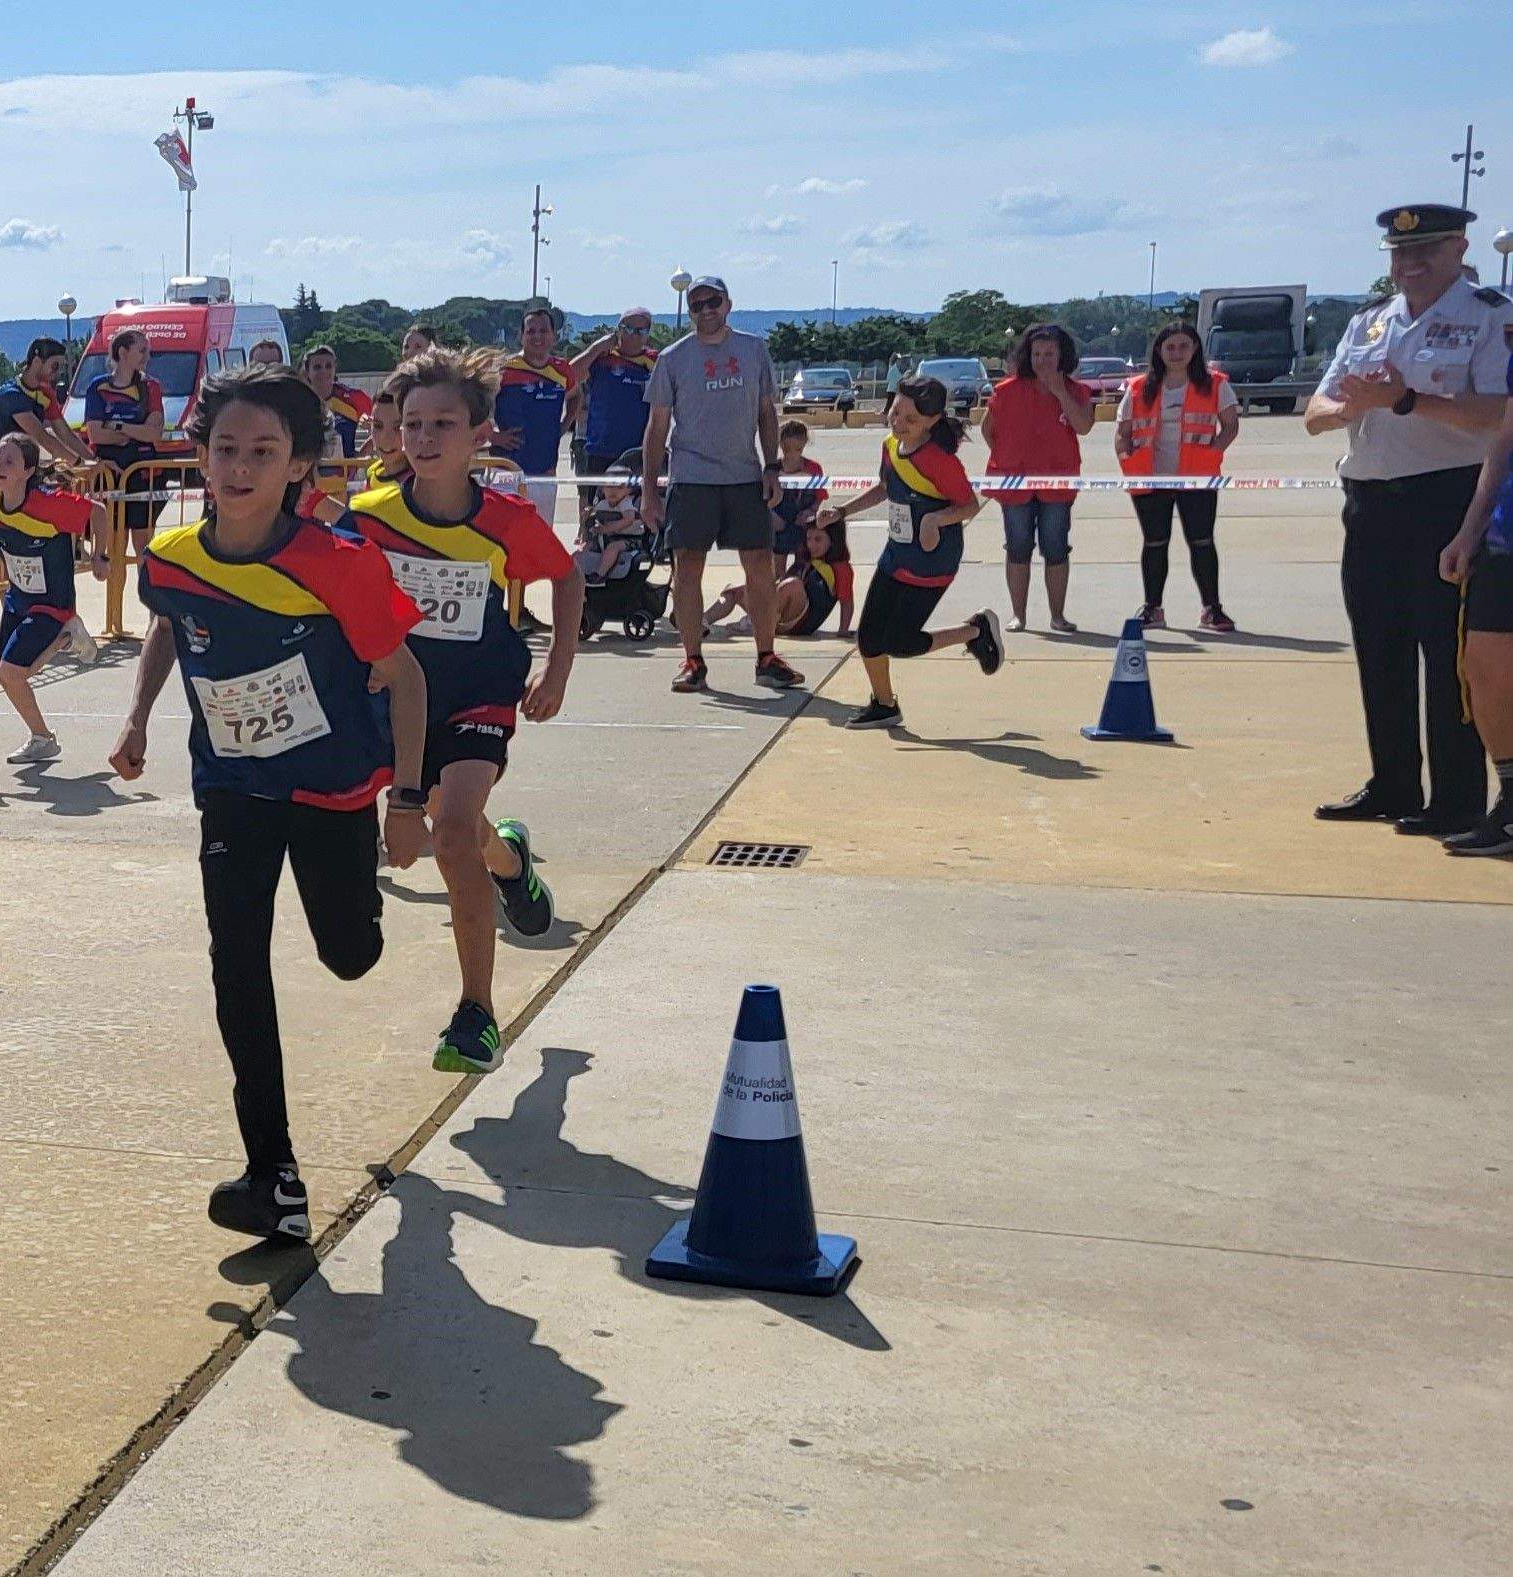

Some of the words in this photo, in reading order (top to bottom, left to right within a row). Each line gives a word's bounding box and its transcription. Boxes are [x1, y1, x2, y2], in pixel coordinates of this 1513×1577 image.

[705, 376, 744, 392] RUN
[419, 597, 462, 624] 20
[223, 703, 295, 744] 725
[726, 1070, 787, 1089] Mutualidad
[722, 1083, 734, 1097] de
[735, 1086, 748, 1101] la
